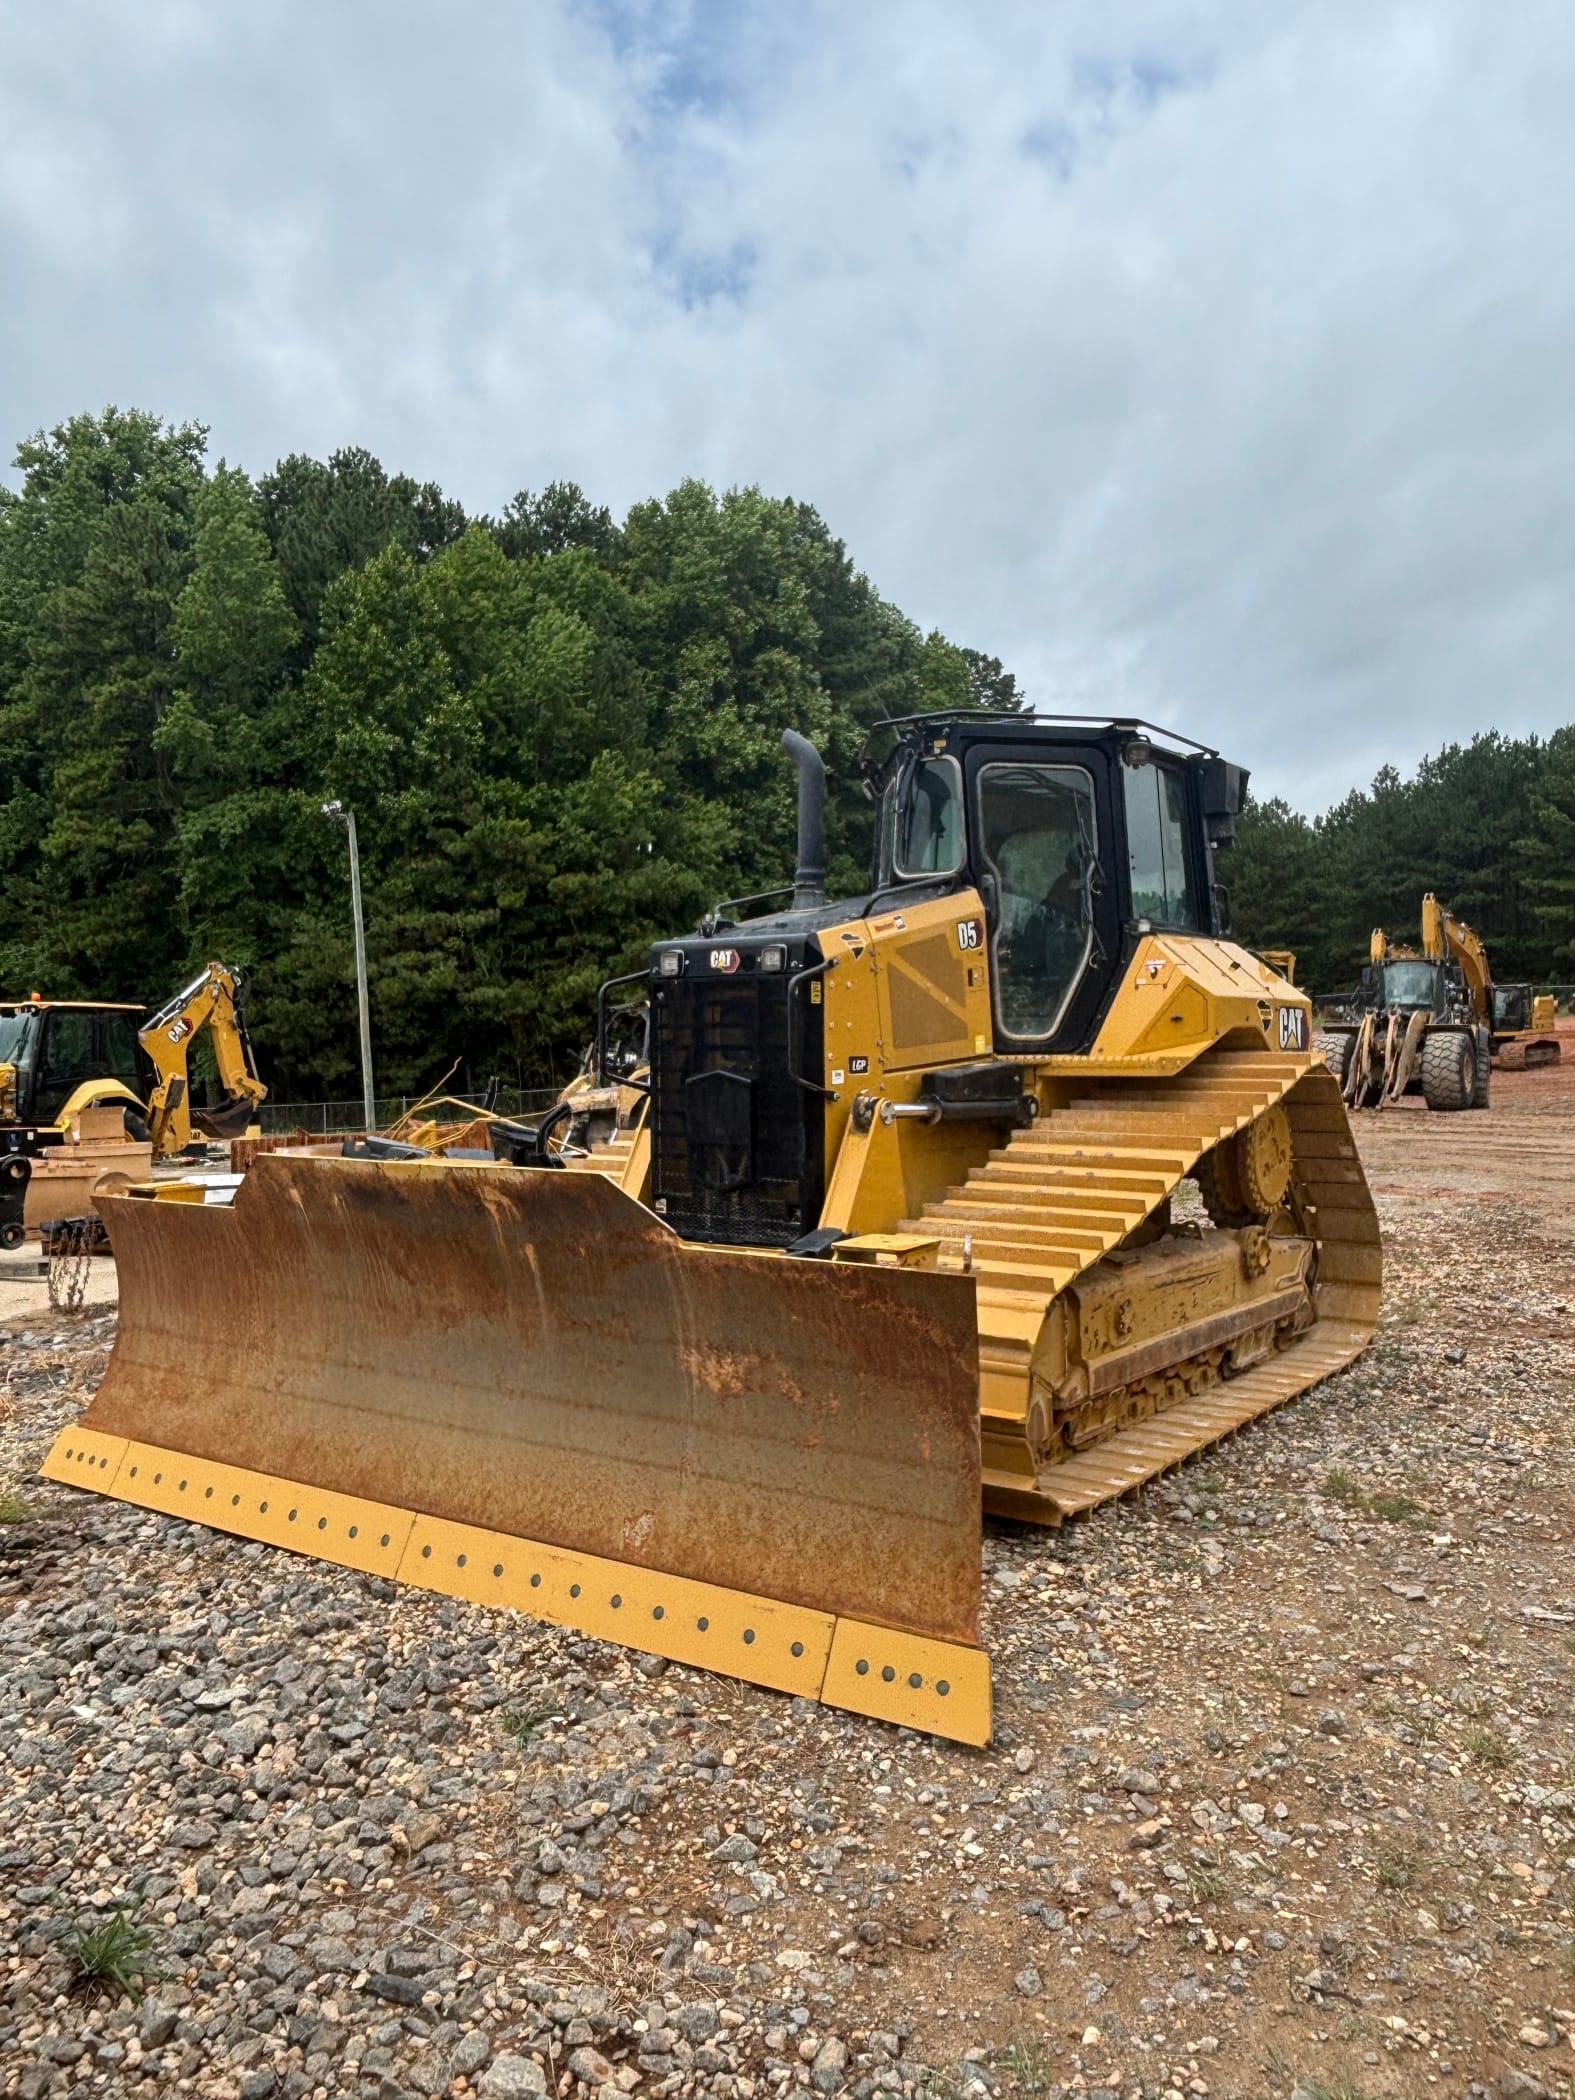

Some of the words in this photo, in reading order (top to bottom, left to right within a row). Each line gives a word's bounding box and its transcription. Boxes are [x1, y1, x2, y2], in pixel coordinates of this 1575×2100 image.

[957, 921, 978, 949] D5
[710, 950, 732, 968] CAT
[167, 1019, 189, 1043] CAT
[1279, 1007, 1303, 1049] CAT
